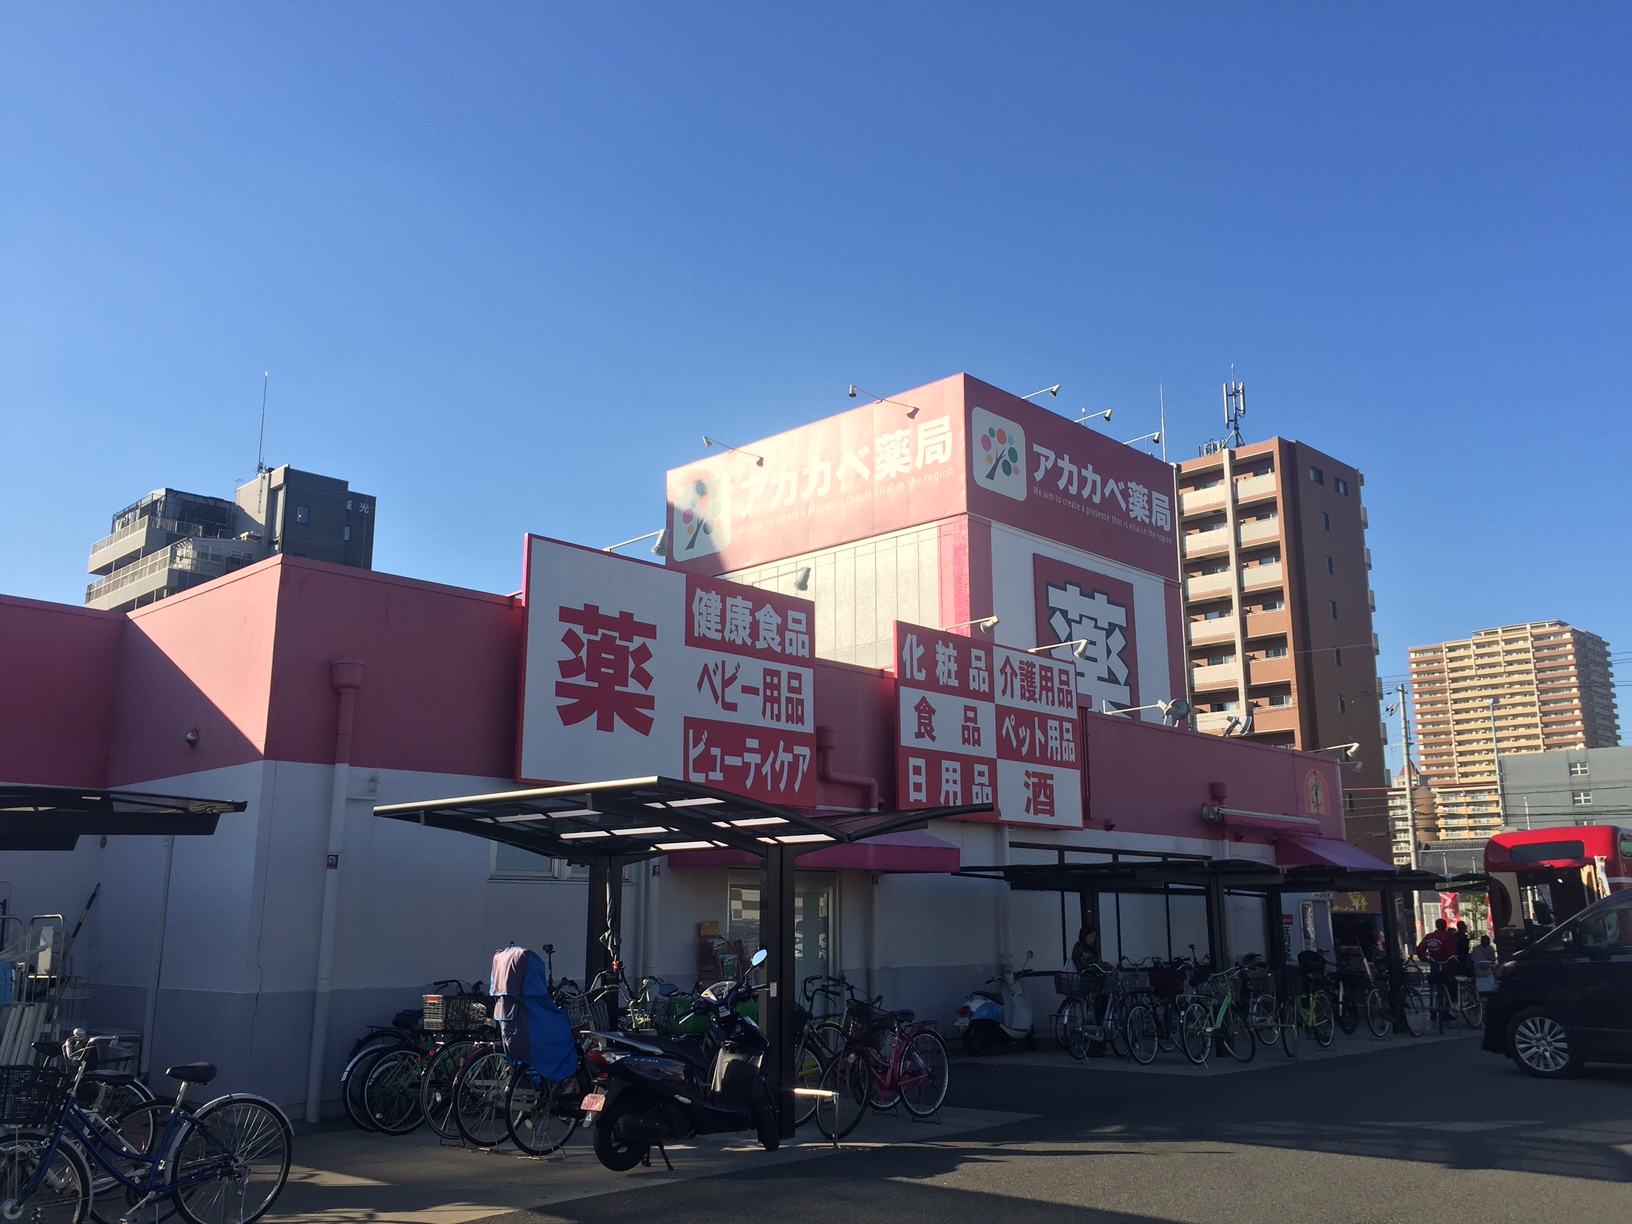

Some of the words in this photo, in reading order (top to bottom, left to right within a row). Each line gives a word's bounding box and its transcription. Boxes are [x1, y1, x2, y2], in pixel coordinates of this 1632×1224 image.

[739, 415, 953, 519] アカカベ薬局
[1032, 443, 1171, 532] アカカベ薬局
[738, 523, 750, 534] We
[750, 519, 764, 532] aim
[766, 517, 774, 527] to
[775, 510, 799, 524] create
[801, 509, 806, 517] a
[807, 498, 843, 518] presence
[846, 492, 863, 504] that
[865, 489, 873, 499] is
[874, 483, 894, 497] vital
[895, 480, 905, 491] in
[908, 476, 921, 488] the
[924, 467, 954, 483] region
[1032, 486, 1042, 497] We
[1043, 491, 1055, 501] aim
[1055, 495, 1062, 504] to
[1062, 498, 1081, 511] create
[1081, 505, 1085, 513] a
[1086, 507, 1110, 522] presence
[1111, 515, 1123, 526] that
[1123, 519, 1129, 529] is
[1129, 522, 1141, 534] vital
[1141, 527, 1147, 536] in
[1147, 529, 1156, 539] the
[1156, 533, 1173, 545] region
[692, 587, 810, 658] 健康食品
[1047, 581, 1132, 718] 薬
[555, 603, 657, 736] 薬
[697, 659, 805, 725] ベビー用品
[902, 633, 989, 693] 化粧品
[999, 655, 1073, 709] 介護用品
[914, 696, 982, 747] 食品
[1002, 714, 1076, 762] ペット用品
[688, 729, 811, 794] ビューティケア
[908, 757, 993, 806] 日用品
[1024, 769, 1055, 817] 酒
